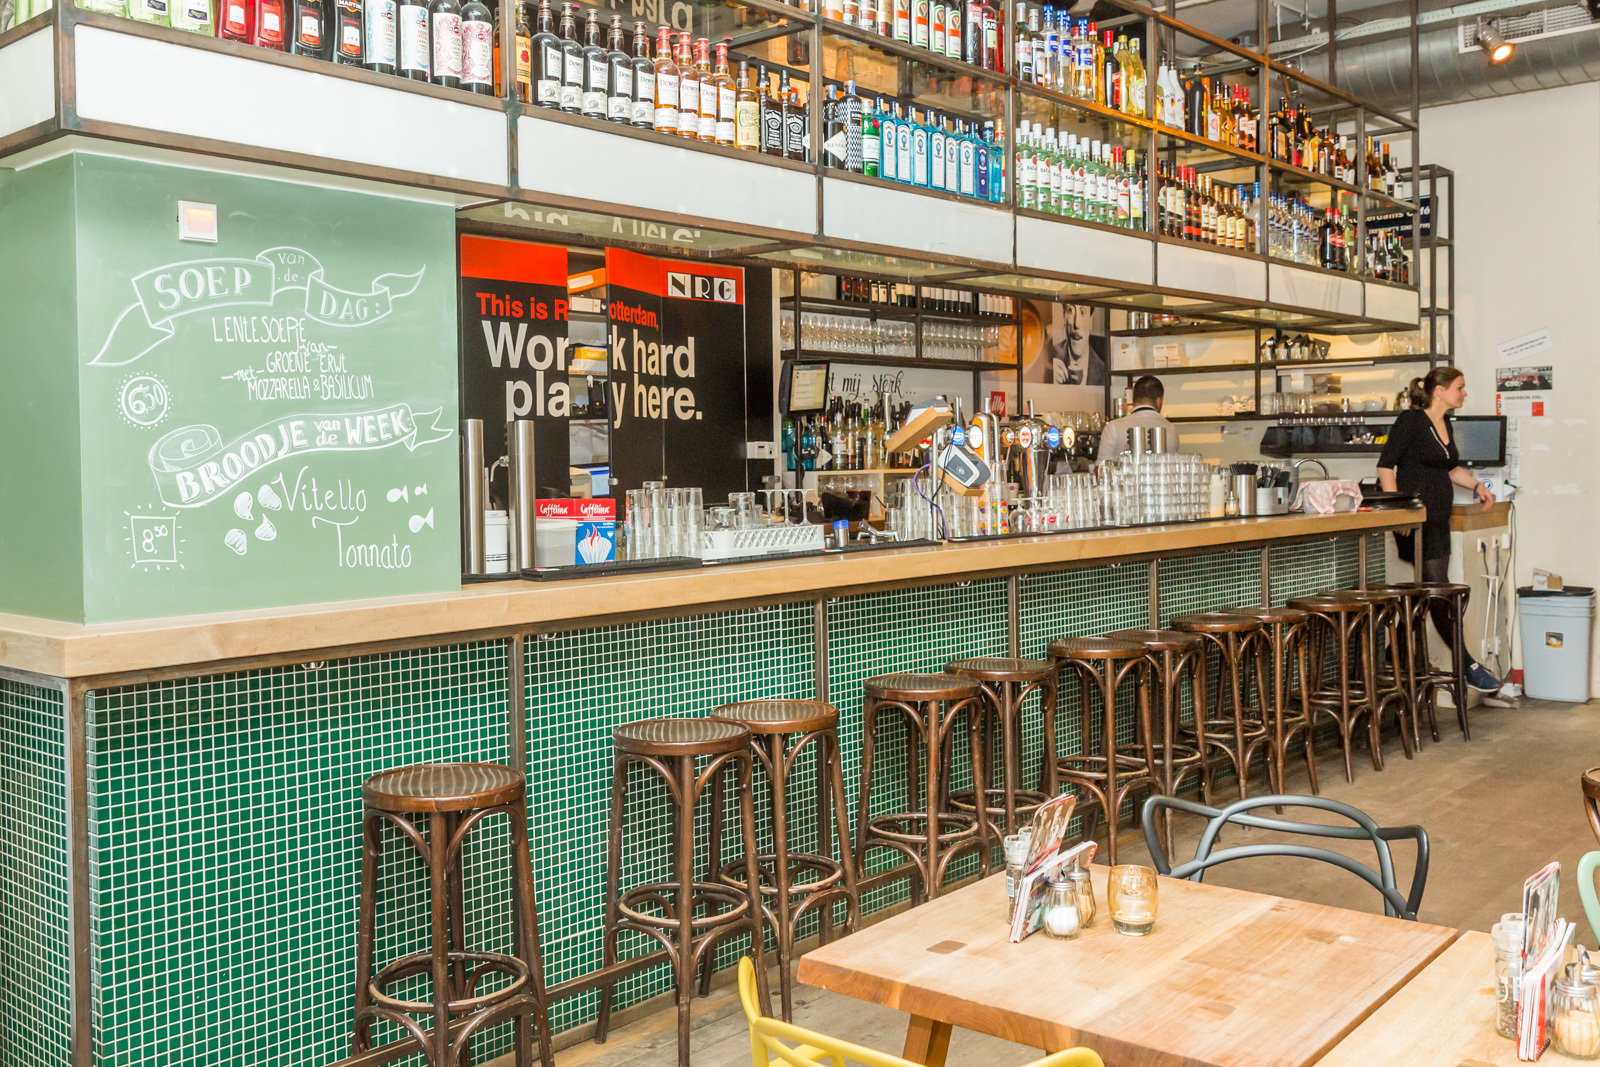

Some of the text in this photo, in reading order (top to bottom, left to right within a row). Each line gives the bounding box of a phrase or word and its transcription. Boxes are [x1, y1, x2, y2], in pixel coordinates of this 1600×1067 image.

[277, 253, 306, 265] van
[154, 265, 253, 311] SOEP
[476, 292, 523, 318] This
[530, 296, 548, 320] is
[633, 328, 696, 378] hard
[248, 375, 311, 400] MOZZARELLA
[320, 374, 375, 400] BASILICUM
[633, 373, 703, 421] here.
[991, 394, 1005, 414] illy
[314, 419, 342, 433] van
[315, 432, 339, 447] de
[175, 420, 309, 503] BROODJE
[271, 465, 367, 512] Vitello
[312, 516, 412, 568] Tonnato
